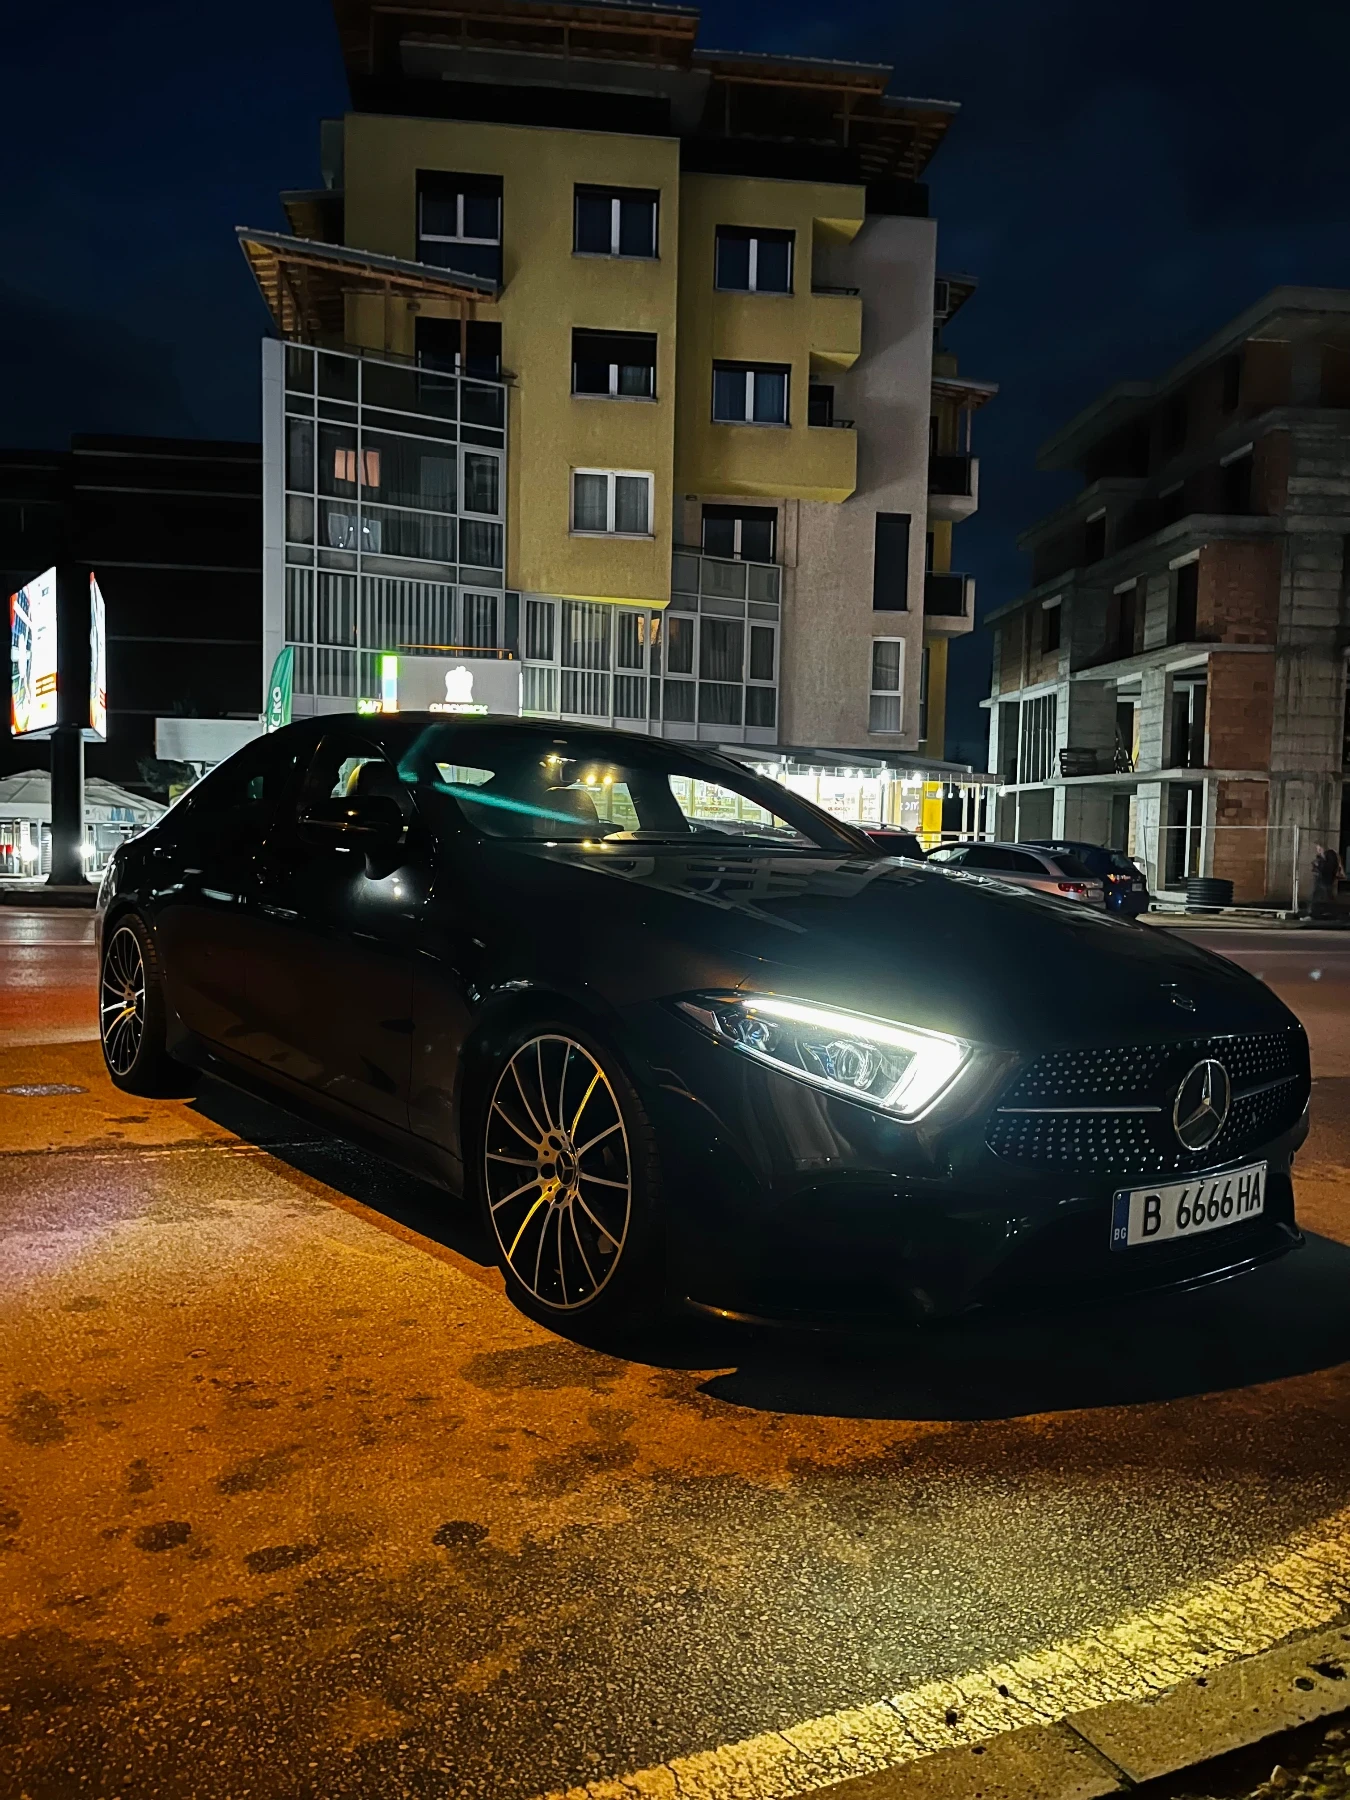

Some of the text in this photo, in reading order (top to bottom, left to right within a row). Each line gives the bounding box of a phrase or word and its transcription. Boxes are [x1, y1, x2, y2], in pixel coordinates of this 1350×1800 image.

[1142, 1172, 1261, 1237] B 6666 HA
[1113, 1226, 1127, 1241] BG
